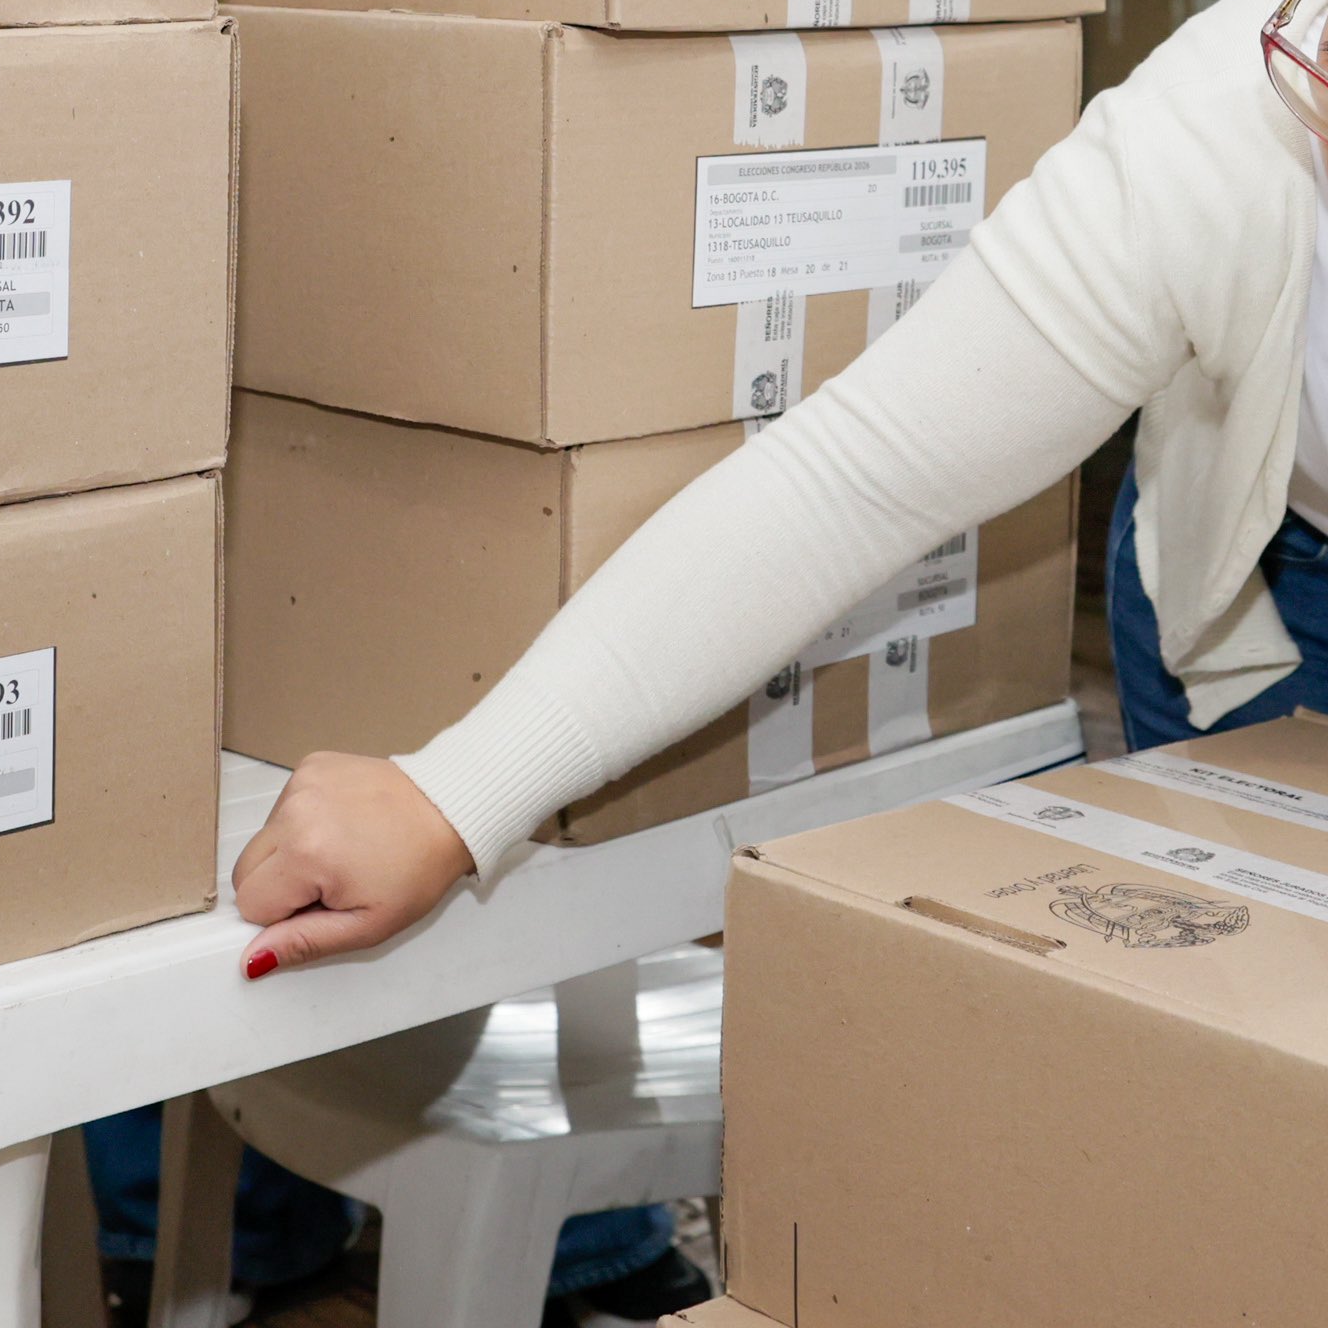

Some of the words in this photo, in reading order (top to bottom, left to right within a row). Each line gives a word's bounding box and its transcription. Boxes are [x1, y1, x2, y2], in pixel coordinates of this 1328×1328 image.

[912, 157, 967, 182] 119,395
[709, 191, 759, 204] 16-BOGOTA
[761, 190, 779, 201] D.C.
[708, 214, 769, 228] 13-LOCALIDAD
[773, 213, 783, 224] 13
[786, 209, 842, 224] TEUSAQUILLO
[707, 236, 790, 252] 1318-TEUSAQUILLO
[765, 296, 773, 341] SEÑORES
[1190, 768, 1216, 777] KIT
[1219, 774, 1303, 801] ELECTORAL
